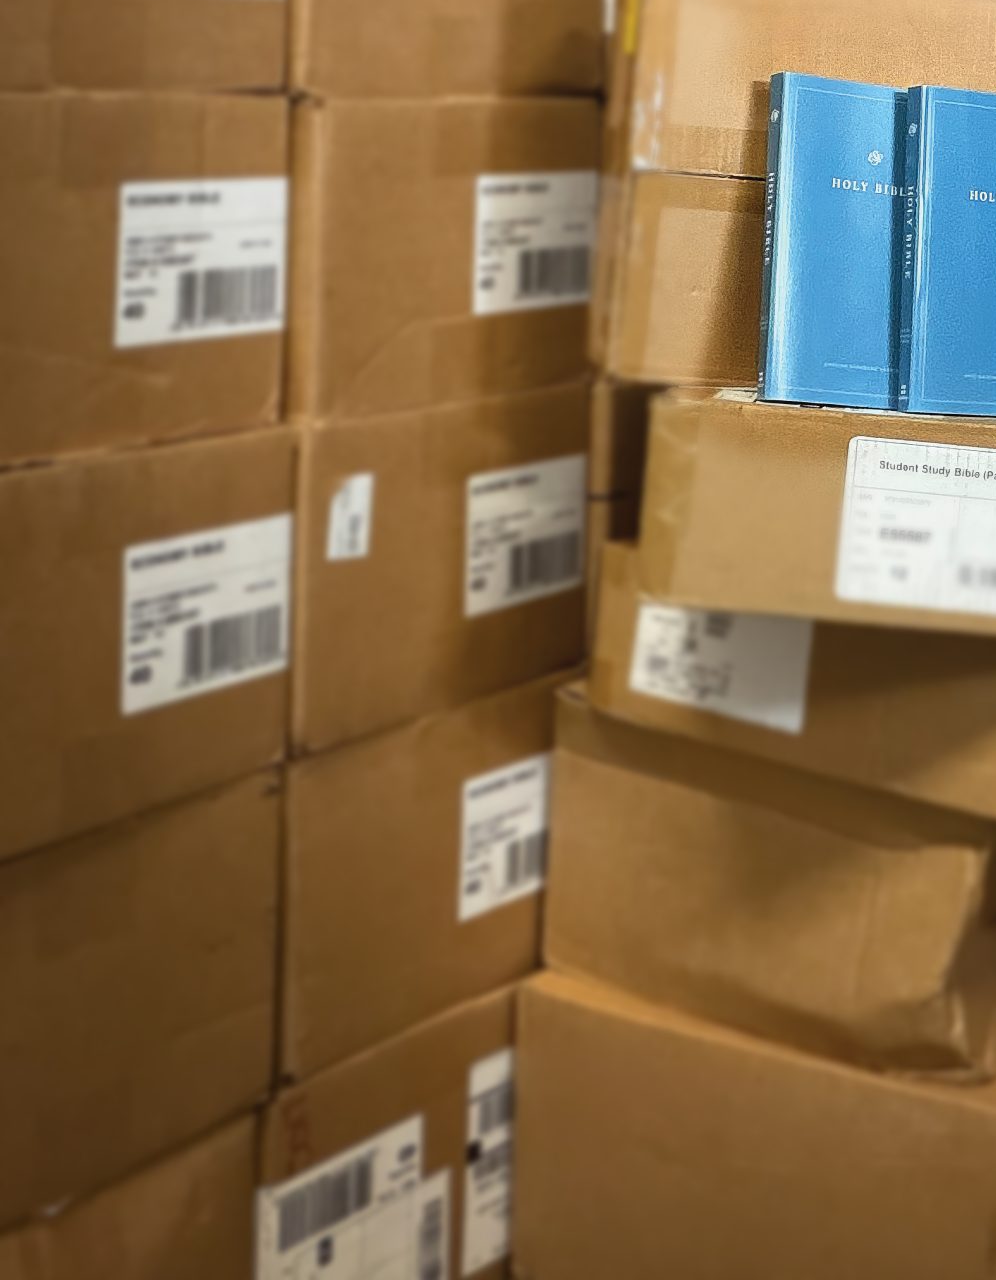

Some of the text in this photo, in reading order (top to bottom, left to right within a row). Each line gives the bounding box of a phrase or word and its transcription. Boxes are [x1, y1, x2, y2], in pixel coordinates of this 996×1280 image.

[766, 172, 775, 211] HOLY
[831, 177, 908, 197] HOLY BIBL
[906, 186, 915, 226] HOLY
[879, 460, 919, 473] Student
[922, 464, 950, 477] Study
[954, 468, 980, 479] Bible
